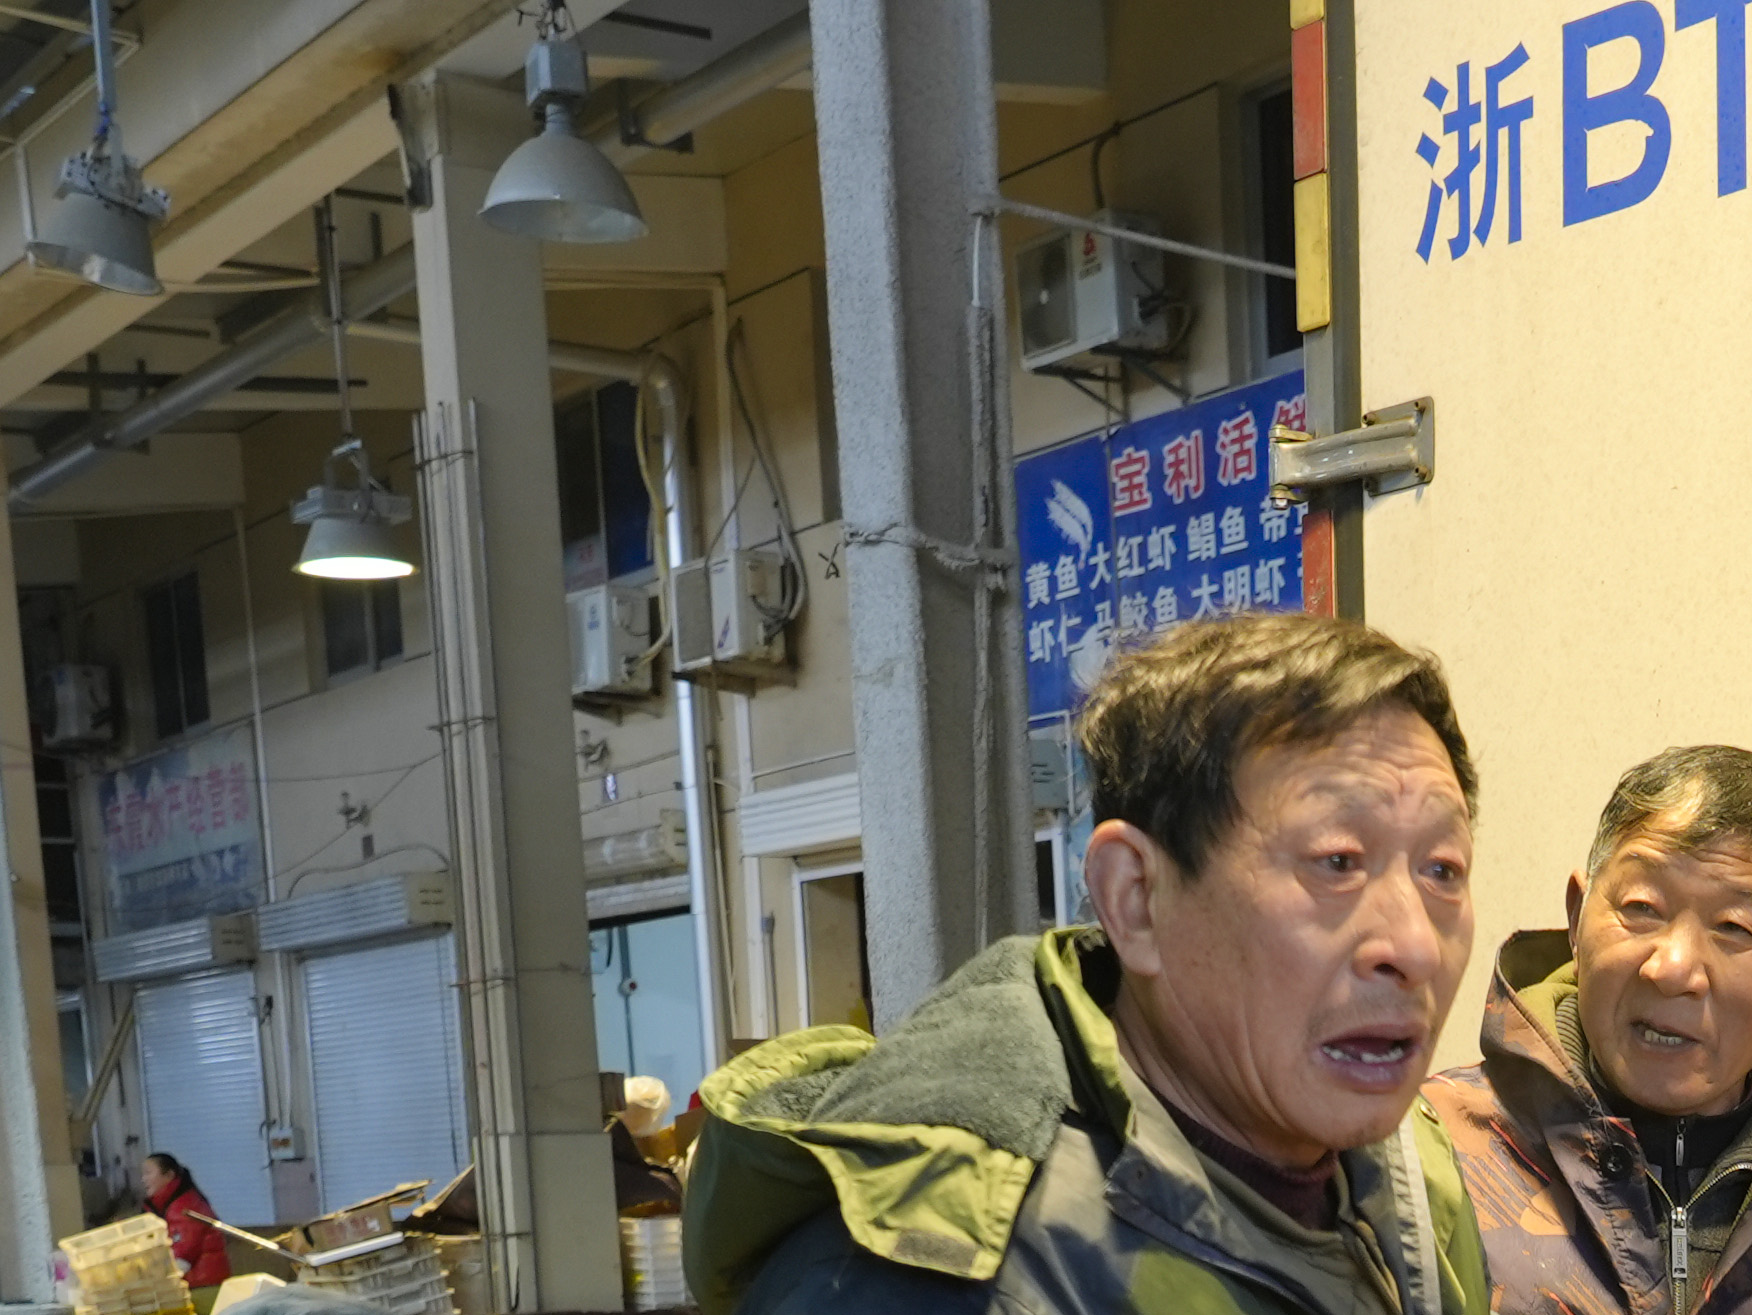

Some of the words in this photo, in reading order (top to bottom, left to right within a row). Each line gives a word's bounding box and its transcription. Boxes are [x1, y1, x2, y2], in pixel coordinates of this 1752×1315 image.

[1025, 556, 1080, 609] 黄鱼
[1089, 524, 1177, 590] 大红虾
[1029, 615, 1083, 665] 虾仁
